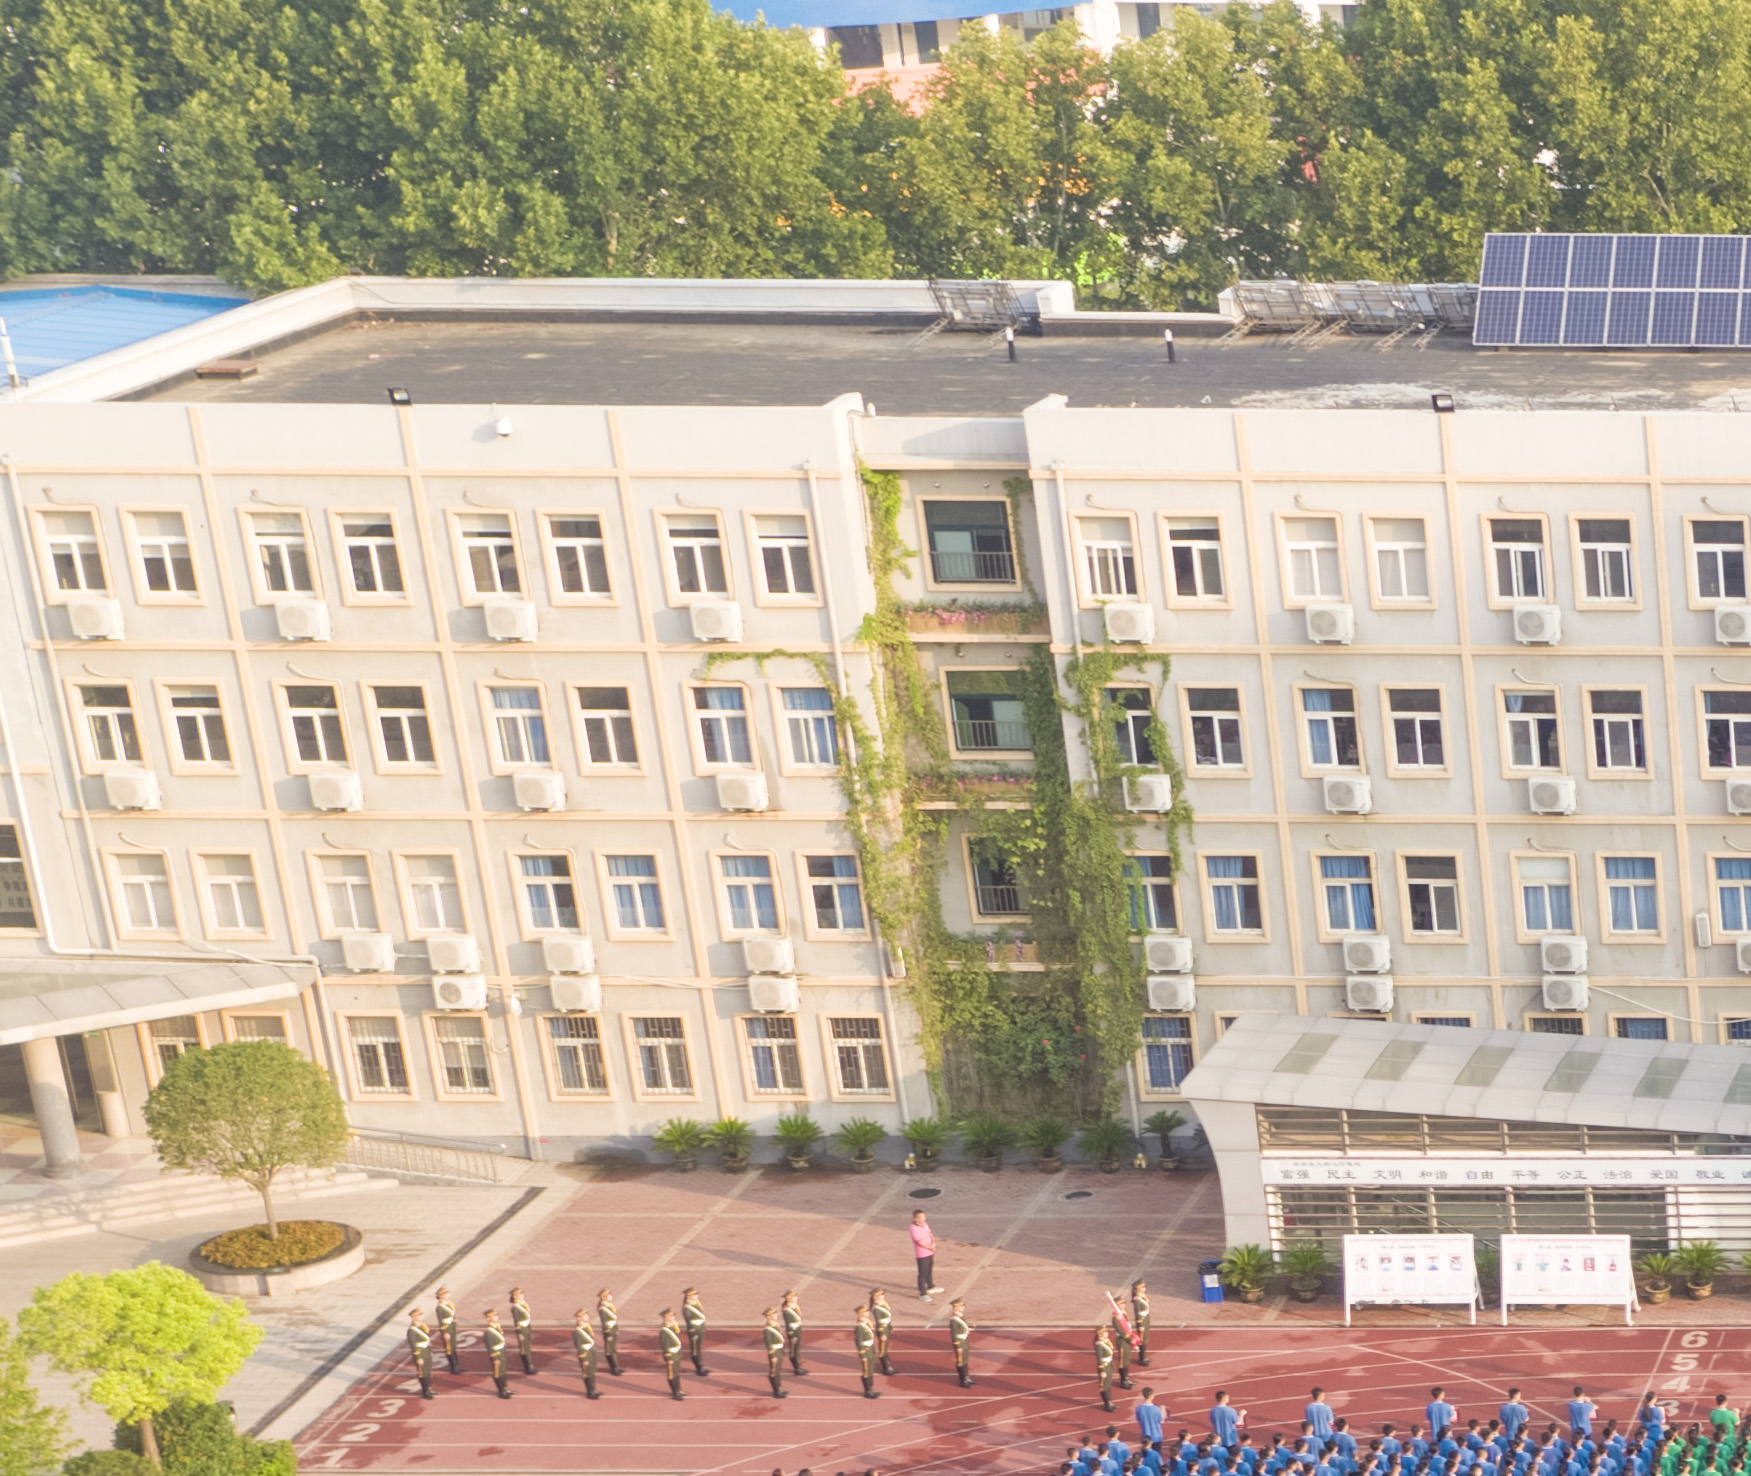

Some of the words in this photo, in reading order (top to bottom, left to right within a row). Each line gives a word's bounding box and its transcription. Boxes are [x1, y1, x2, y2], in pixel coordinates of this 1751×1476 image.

[1280, 1169, 1311, 1180] 富强
[1327, 1169, 1358, 1180] 民主
[1372, 1169, 1403, 1180] 文明
[1418, 1169, 1449, 1180] 和谐
[1465, 1169, 1495, 1180] 自由
[1511, 1169, 1541, 1180] 平等
[1556, 1169, 1588, 1180] 公正
[1603, 1169, 1633, 1180] 法治
[1649, 1169, 1679, 1180] 爱国
[1696, 1169, 1726, 1180] 敬业
[1681, 1331, 1709, 1348] 6
[1670, 1353, 1699, 1371] 5
[1660, 1375, 1691, 1392] 4
[366, 1399, 406, 1418] 3
[1656, 1399, 1680, 1417] 3
[338, 1422, 381, 1441] 2
[316, 1447, 351, 1467] 1
